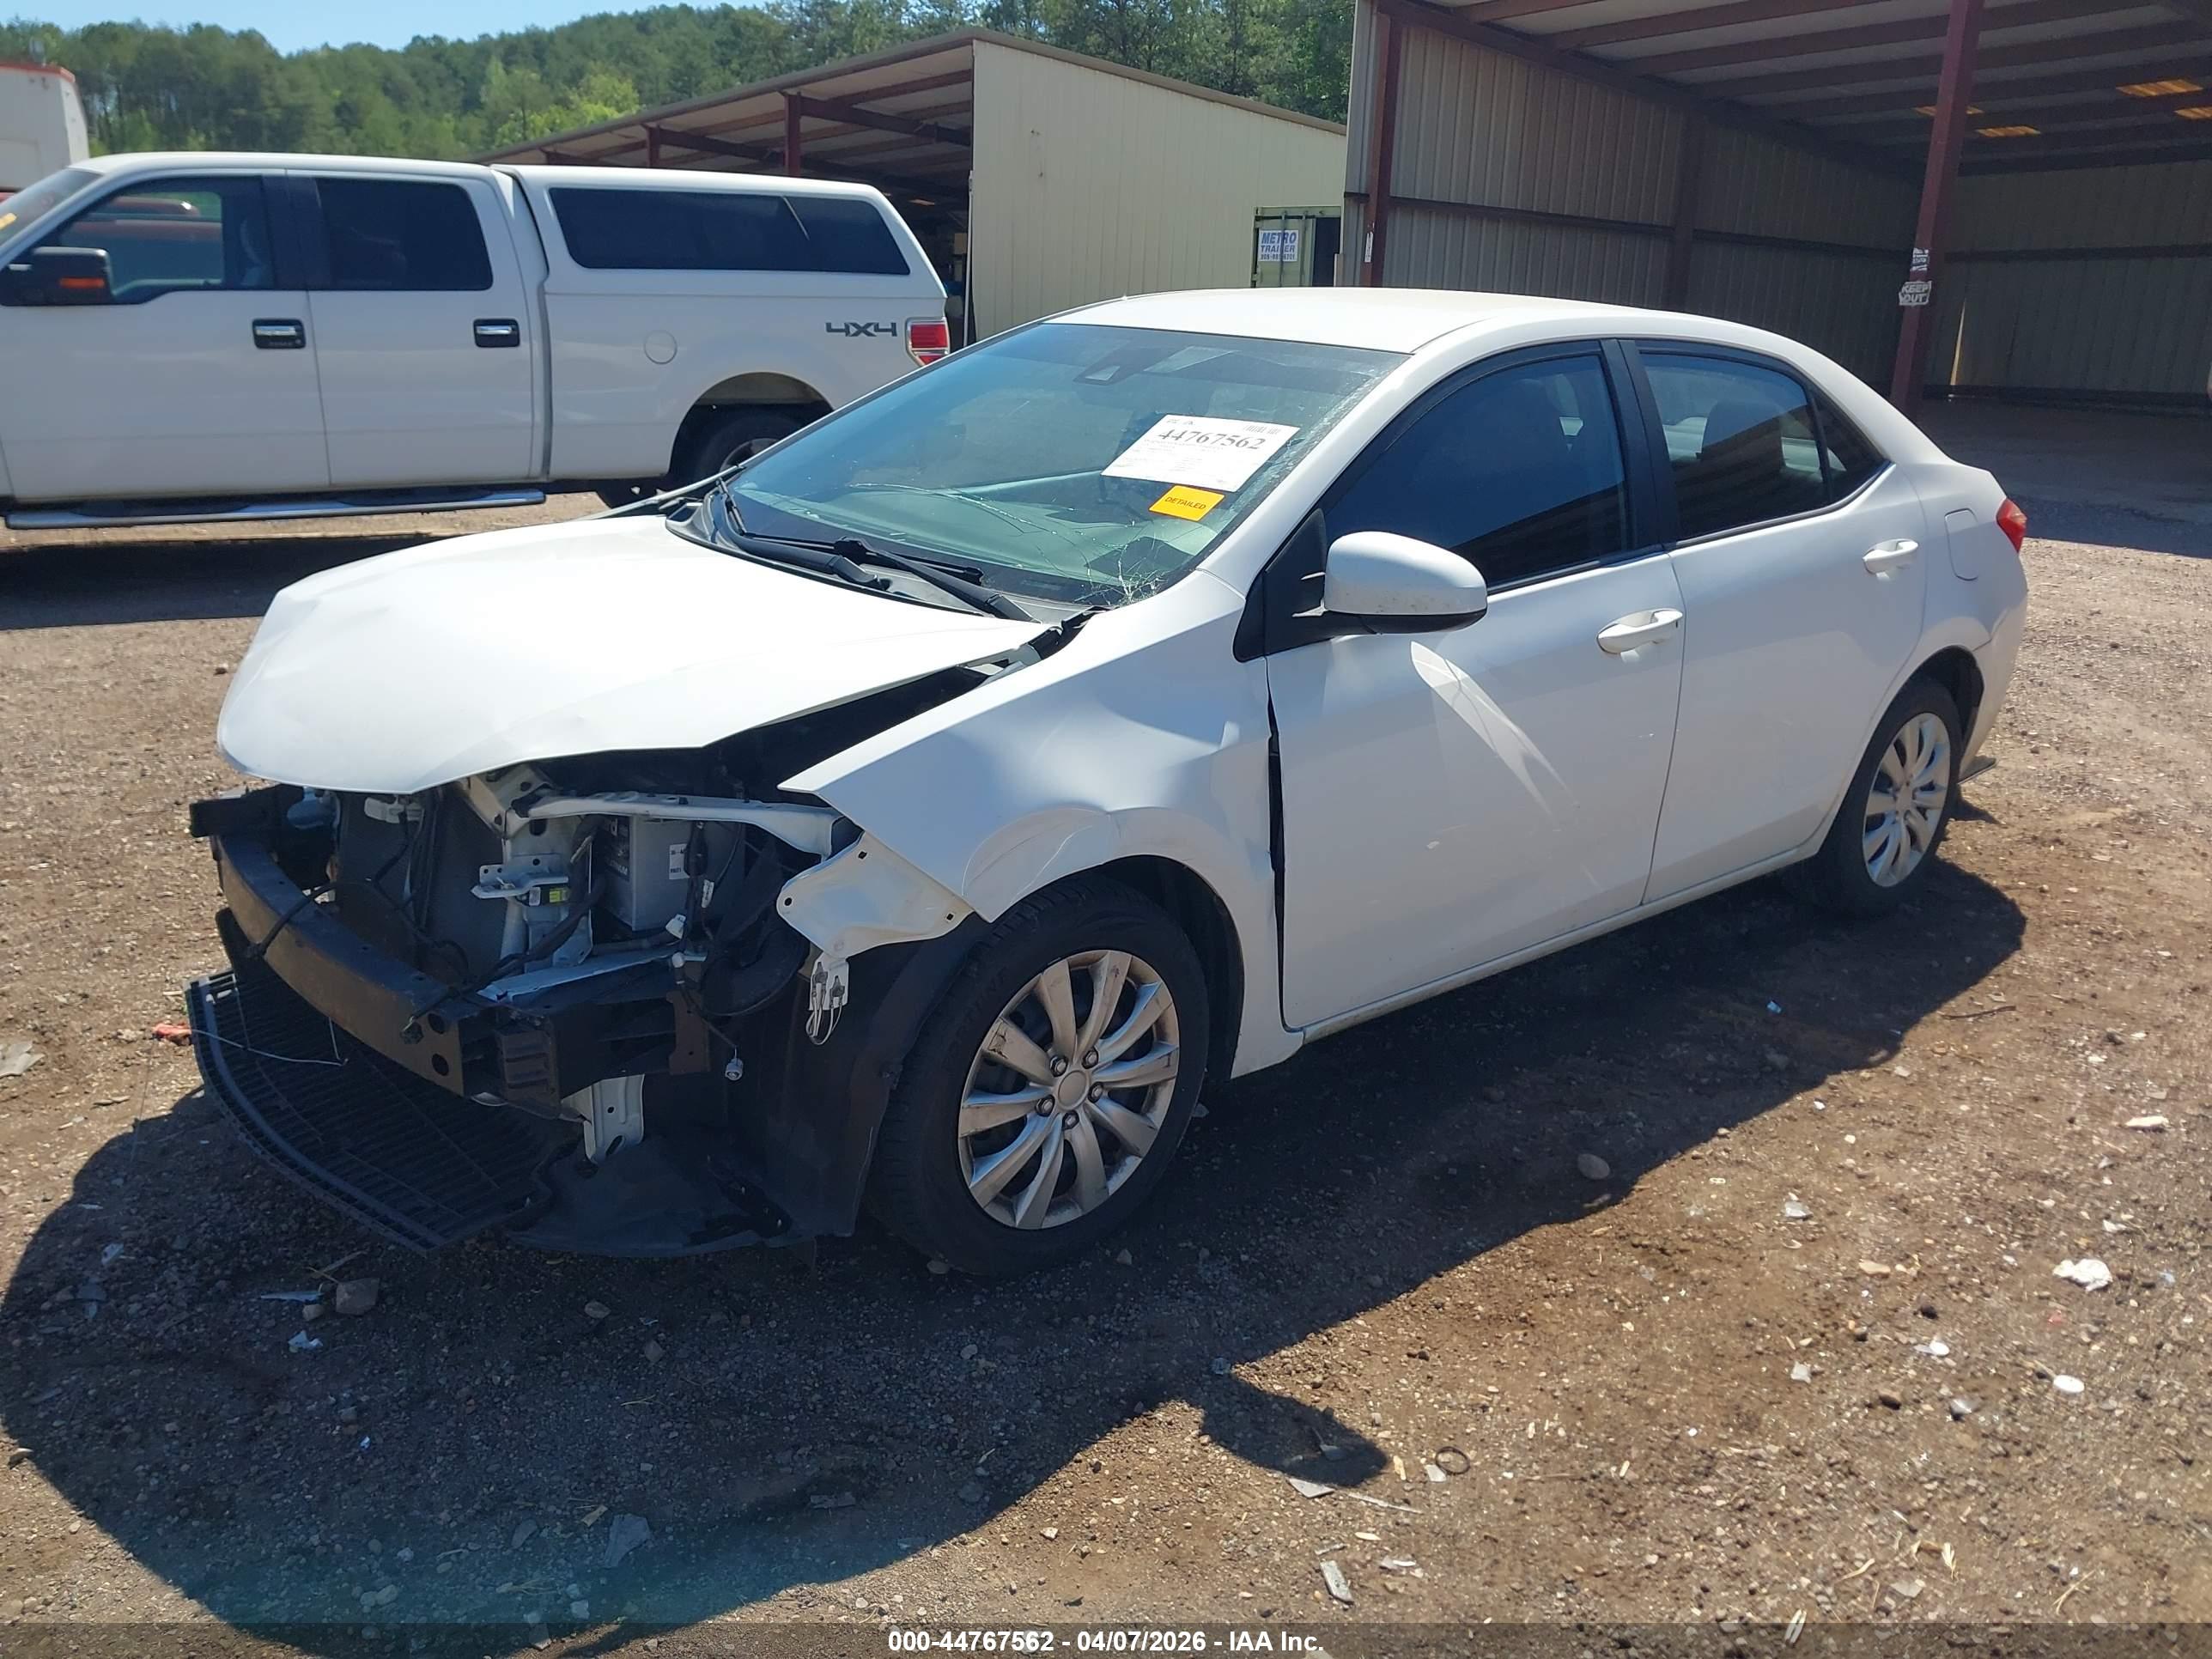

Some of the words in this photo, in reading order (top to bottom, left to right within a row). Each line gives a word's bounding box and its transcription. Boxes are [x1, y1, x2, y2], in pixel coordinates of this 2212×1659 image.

[1261, 232, 1297, 244] METRO
[1901, 283, 1929, 294] KEEP
[1902, 294, 1924, 302] OUT
[1158, 428, 1267, 450] 44767562
[1164, 495, 1207, 511] DETAILED
